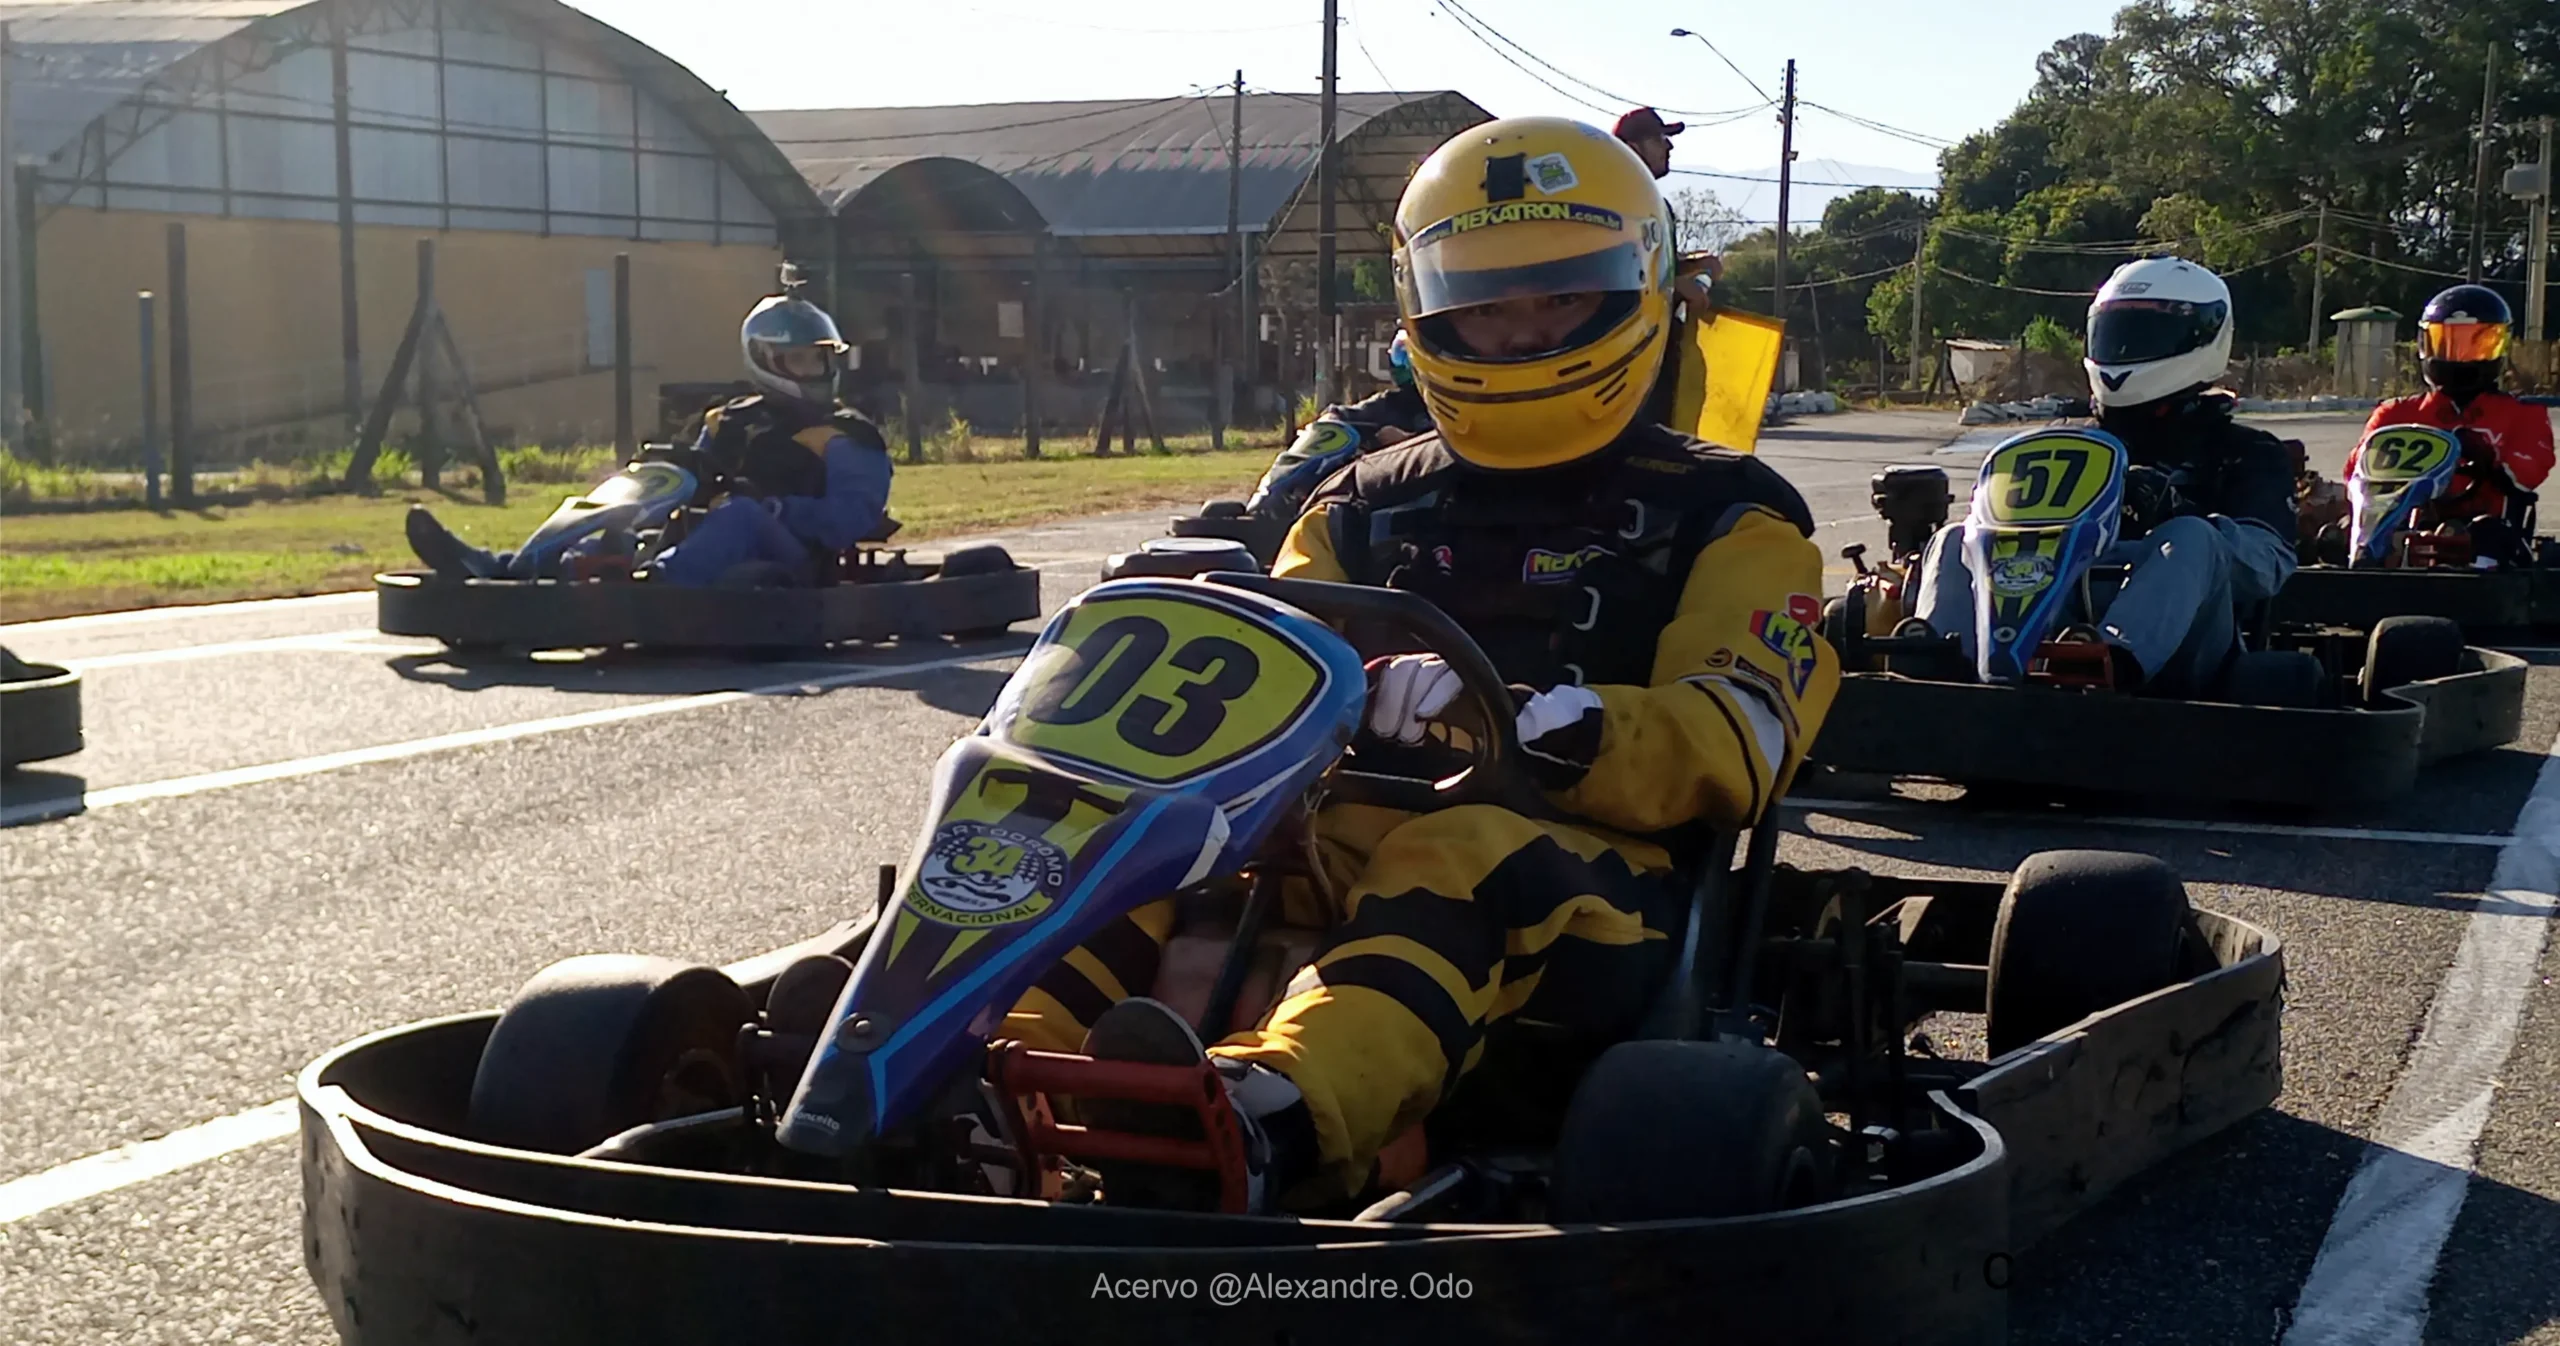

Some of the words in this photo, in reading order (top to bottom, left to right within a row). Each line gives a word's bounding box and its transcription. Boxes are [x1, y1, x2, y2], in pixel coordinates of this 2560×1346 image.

[2005, 449, 2089, 510] 57
[2371, 437, 2433, 473] 62
[1026, 615, 1260, 757] 03
[934, 824, 1063, 888] ARTODROMO
[907, 886, 1040, 925] ERNACIONAL
